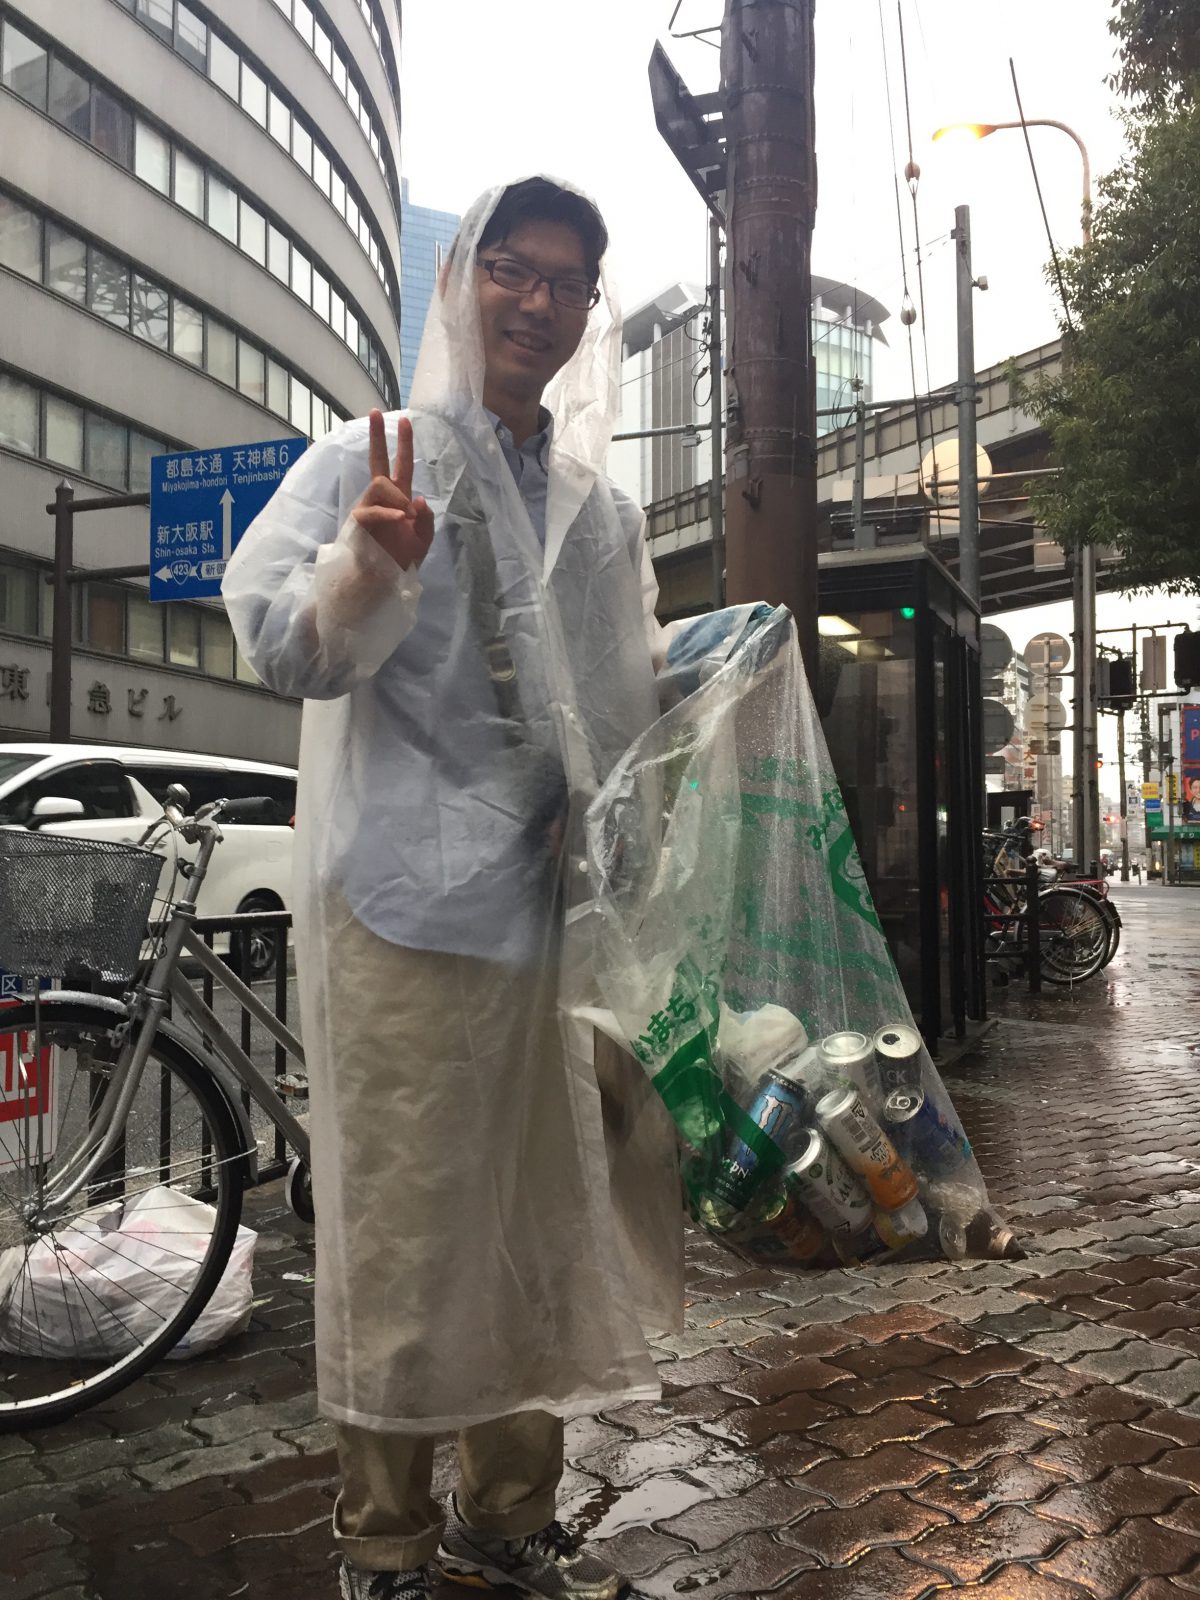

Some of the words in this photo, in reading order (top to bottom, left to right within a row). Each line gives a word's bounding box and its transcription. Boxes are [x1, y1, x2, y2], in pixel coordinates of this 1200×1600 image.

[166, 453, 223, 479] 都島本通
[232, 444, 289, 472] 天神橋6
[162, 475, 228, 494] Miyakojima-hondori
[156, 519, 214, 545] 新大阪駅
[154, 545, 198, 559] Shin-osaka
[201, 543, 217, 554] Sta.
[173, 563, 189, 576] 423
[0, 662, 184, 722] 東急ビル
